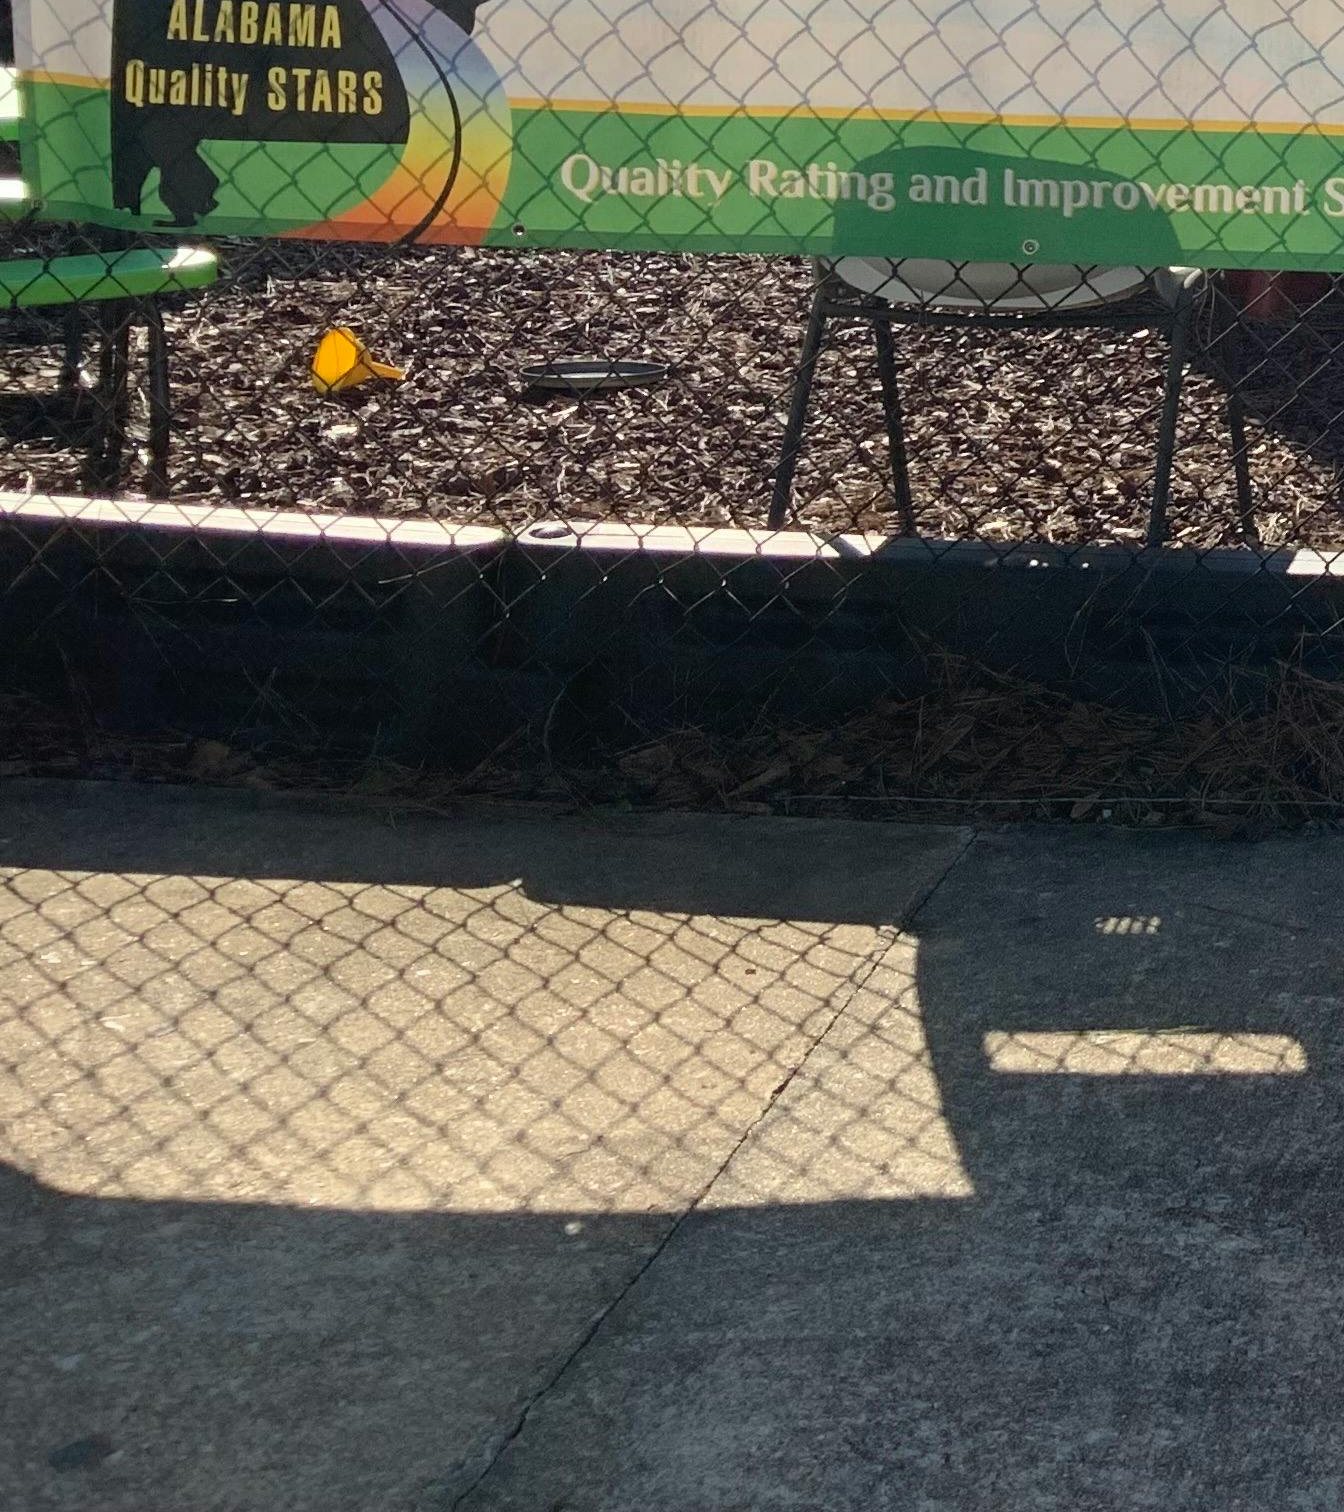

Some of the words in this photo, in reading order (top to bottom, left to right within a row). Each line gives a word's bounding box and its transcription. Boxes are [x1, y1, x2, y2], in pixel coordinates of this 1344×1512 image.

[125, 61, 248, 115] Quality
[267, 67, 383, 115] STARS
[561, 153, 731, 206] Quality
[748, 160, 895, 213] Rating
[909, 168, 988, 205] and
[1004, 170, 1310, 218] Improvement
